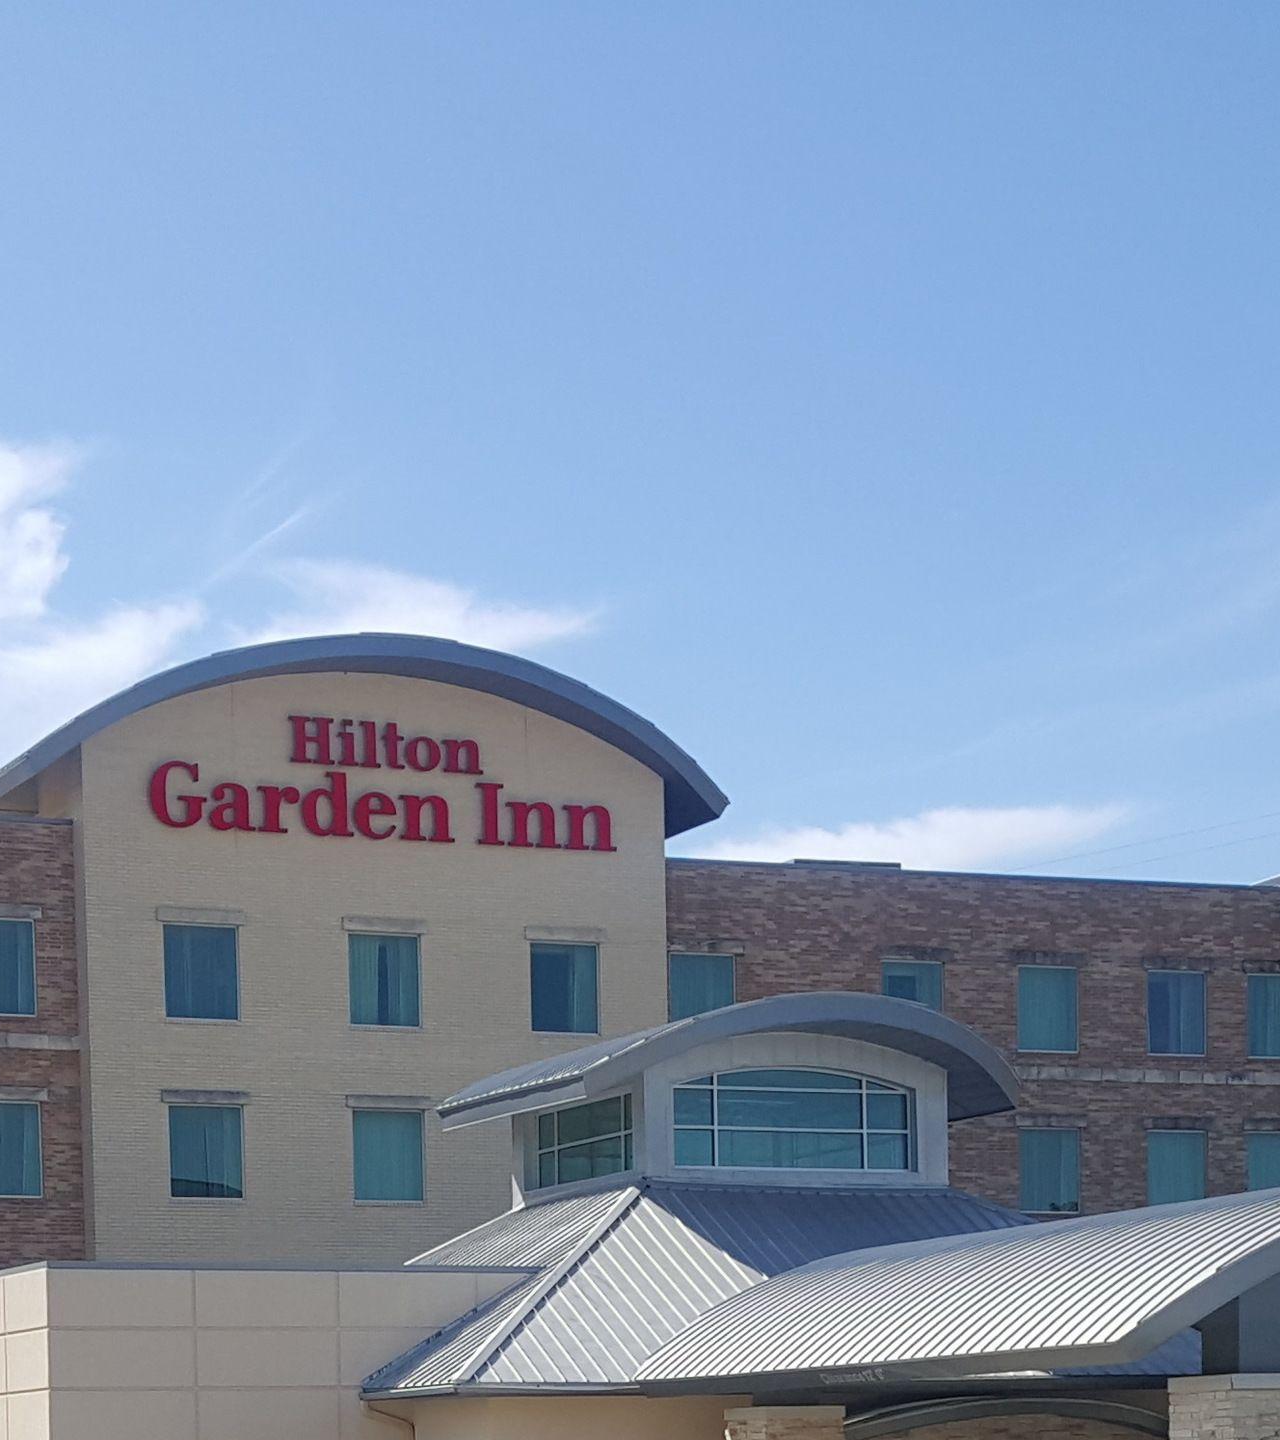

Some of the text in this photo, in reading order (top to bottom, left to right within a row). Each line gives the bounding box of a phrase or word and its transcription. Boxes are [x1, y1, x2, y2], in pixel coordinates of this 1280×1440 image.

[288, 715, 483, 775] Hilton
[148, 760, 617, 852] Garden Inn
